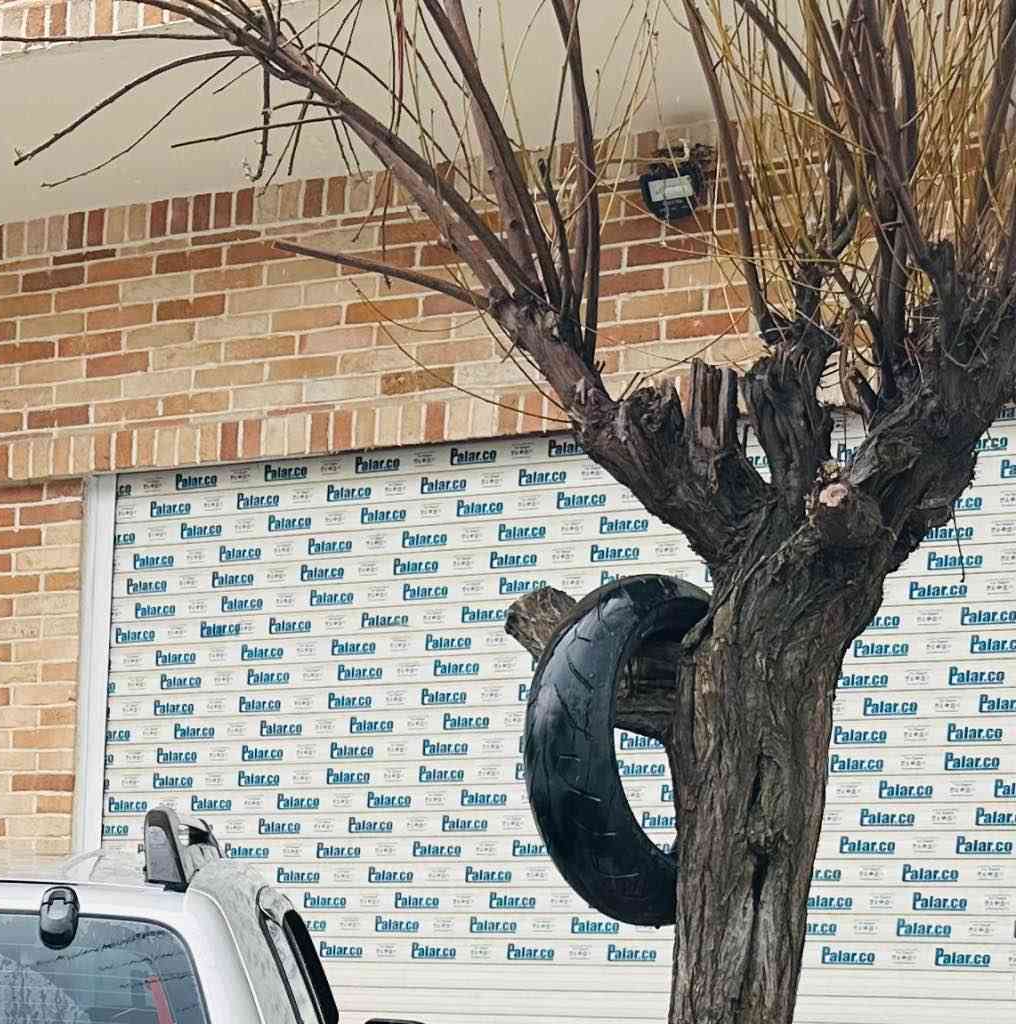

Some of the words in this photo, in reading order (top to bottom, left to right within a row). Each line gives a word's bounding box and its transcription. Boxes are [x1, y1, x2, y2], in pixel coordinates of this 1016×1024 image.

[355, 455, 400, 474] Palar.co
[450, 447, 497, 466] Palar.co
[175, 472, 218, 490] Palar.co
[264, 464, 308, 482] Palar.co
[519, 469, 566, 486] Palar.co
[327, 485, 371, 502] Palar.co
[421, 477, 466, 494] Palar.co
[151, 501, 190, 517] Palar.co
[237, 493, 279, 509] Palar.co
[361, 508, 406, 523] Palar.co
[499, 524, 546, 541] Palar.co
[600, 517, 648, 534] Palar.co
[402, 532, 447, 548] Palar.co
[133, 554, 174, 569] Palar.co
[490, 552, 536, 568] Palar.co
[591, 545, 639, 562] Palar.co
[300, 565, 344, 581] Palar.co
[127, 579, 167, 594] Palar.co
[909, 582, 967, 600] Palar.co
[311, 590, 353, 606] Palar.co
[136, 603, 175, 618] Palar.co
[961, 608, 1016, 625] Palar.co
[200, 623, 240, 638] Palar.co
[269, 618, 311, 634] Palar.co
[115, 627, 155, 643] Palar.co
[331, 640, 376, 655] Palar.co
[854, 640, 908, 658] Palar.co
[156, 651, 196, 666] Palar.co
[434, 660, 479, 676] Palar.co
[948, 666, 1004, 686] Palar.co
[161, 675, 201, 689] Palar.co
[239, 697, 280, 712] Palar.co
[422, 689, 466, 705] Palar.co
[154, 701, 193, 715] Palar.co
[260, 721, 301, 736] Palar.co
[443, 714, 489, 729] Palar.co
[174, 724, 214, 739] Palar.co
[833, 726, 887, 744] Palar.co
[157, 748, 197, 763] Palar.co
[242, 745, 283, 761] Palar.co
[423, 739, 468, 756] Palar.co
[830, 754, 884, 772] Palar.co
[153, 774, 193, 789] Palar.co
[238, 771, 279, 787] Palar.co
[419, 767, 463, 783] Palar.co
[108, 797, 147, 813] Palar.co
[191, 796, 231, 811] Palar.co
[278, 794, 319, 810] Palar.co
[461, 790, 506, 806] Palar.co
[259, 819, 300, 834] Palar.co
[442, 816, 487, 831] Palar.co
[413, 842, 461, 857] Palar.co
[956, 836, 1016, 855] Palar.co
[277, 866, 320, 883] Palar.co
[466, 866, 511, 883] Palar.co
[903, 864, 958, 882] Palar.co
[304, 893, 345, 908] Palar.co
[489, 893, 536, 908] Palar.co
[913, 893, 967, 911] Palar.co
[471, 918, 517, 933] Palar.co
[571, 917, 619, 934] Palar.co
[897, 919, 951, 937] Palar.co
[320, 942, 363, 958] Palar.co
[507, 944, 553, 960] Palar.co
[822, 947, 874, 965] Palar.co
[935, 948, 991, 967] Palar.co
